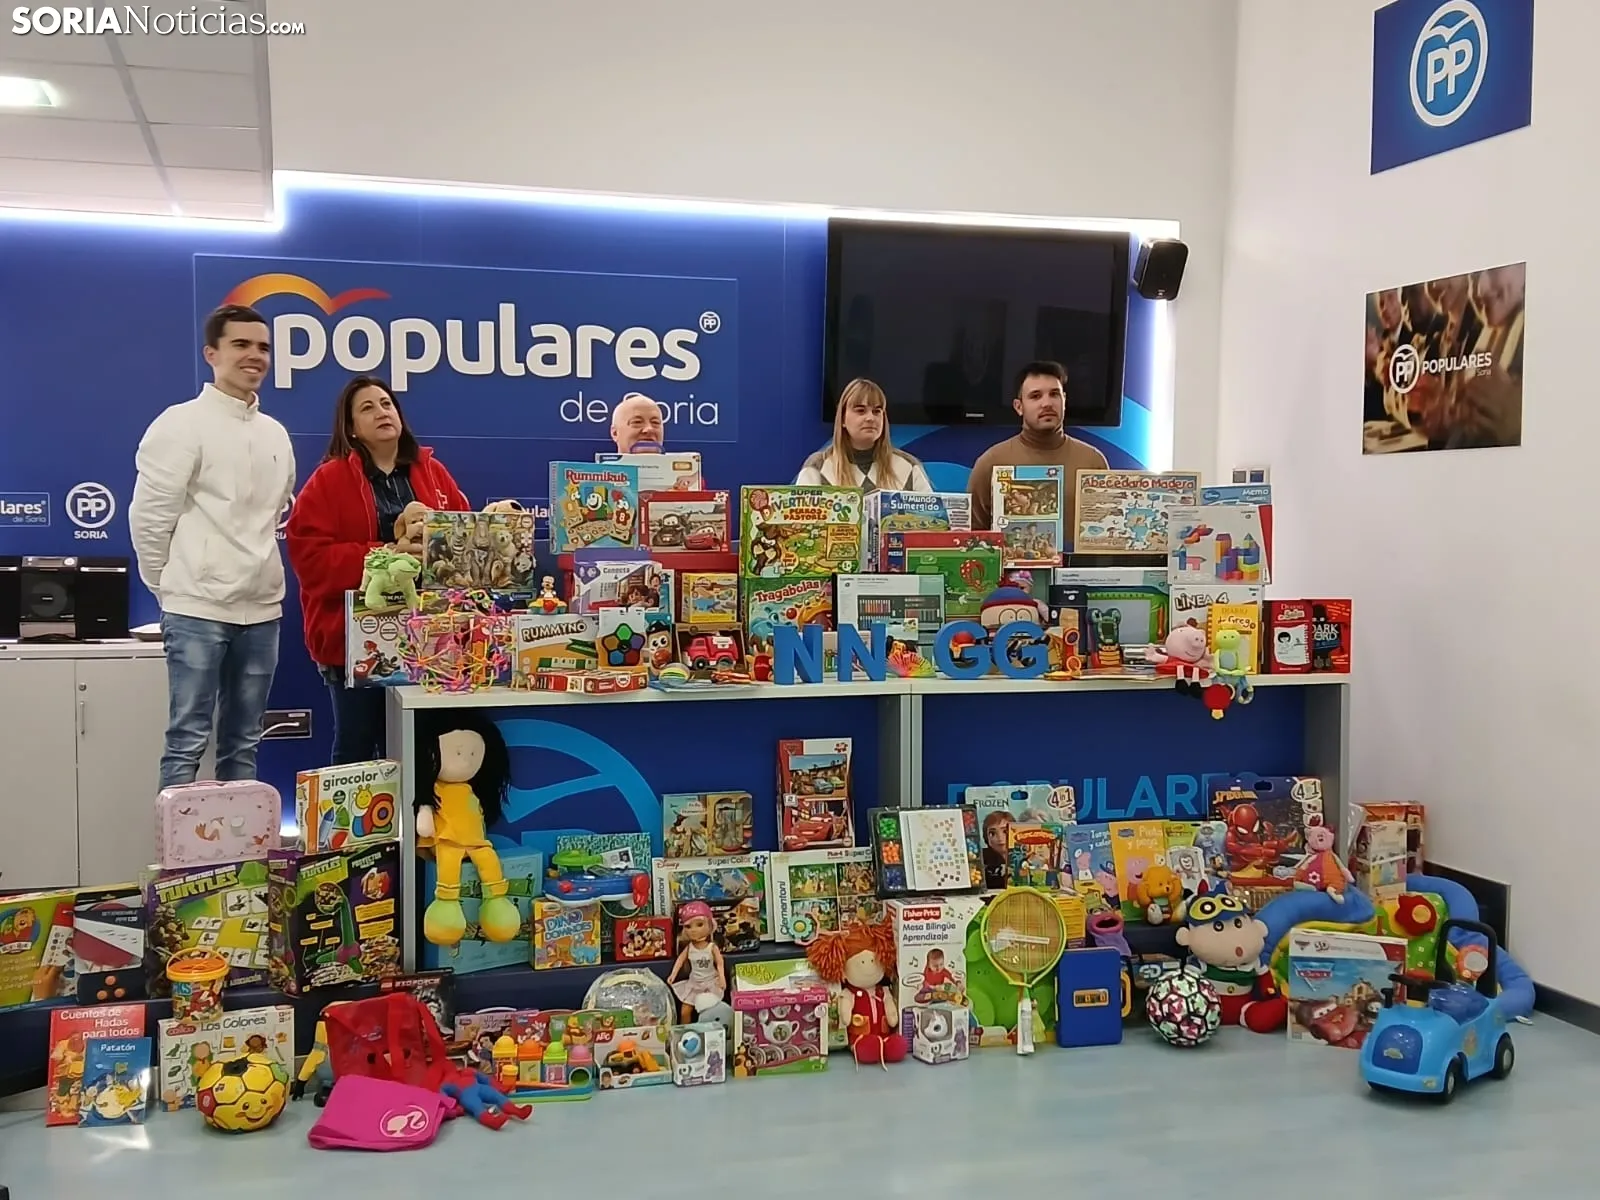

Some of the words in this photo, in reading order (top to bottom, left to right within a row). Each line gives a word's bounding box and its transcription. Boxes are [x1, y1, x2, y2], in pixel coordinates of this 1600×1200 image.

[273, 303, 701, 392] populares
[1422, 352, 1492, 375] POPULARES
[560, 392, 608, 423] de
[623, 392, 719, 425] oria
[565, 469, 628, 484] Rummikub
[1151, 478, 1194, 490] Madera
[890, 500, 939, 511] Sumergido
[908, 495, 937, 503] Mundo
[74, 531, 108, 539] SORIA
[755, 579, 820, 604] Tragabolas
[1216, 592, 1229, 605] 4
[323, 771, 378, 791] girocolor
[973, 798, 1009, 808] FROZEN
[1052, 791, 1059, 805] 4
[156, 871, 240, 904] TURTLES
[777, 880, 789, 936] Clementoni
[60, 1009, 106, 1021] Cuentos
[107, 1008, 121, 1018] de
[95, 1018, 129, 1028] Hadas
[201, 1022, 220, 1032] Los
[223, 1016, 267, 1029] Colores
[82, 1029, 106, 1040] para
[108, 1027, 140, 1037] todos
[100, 1043, 136, 1052] Patatón
